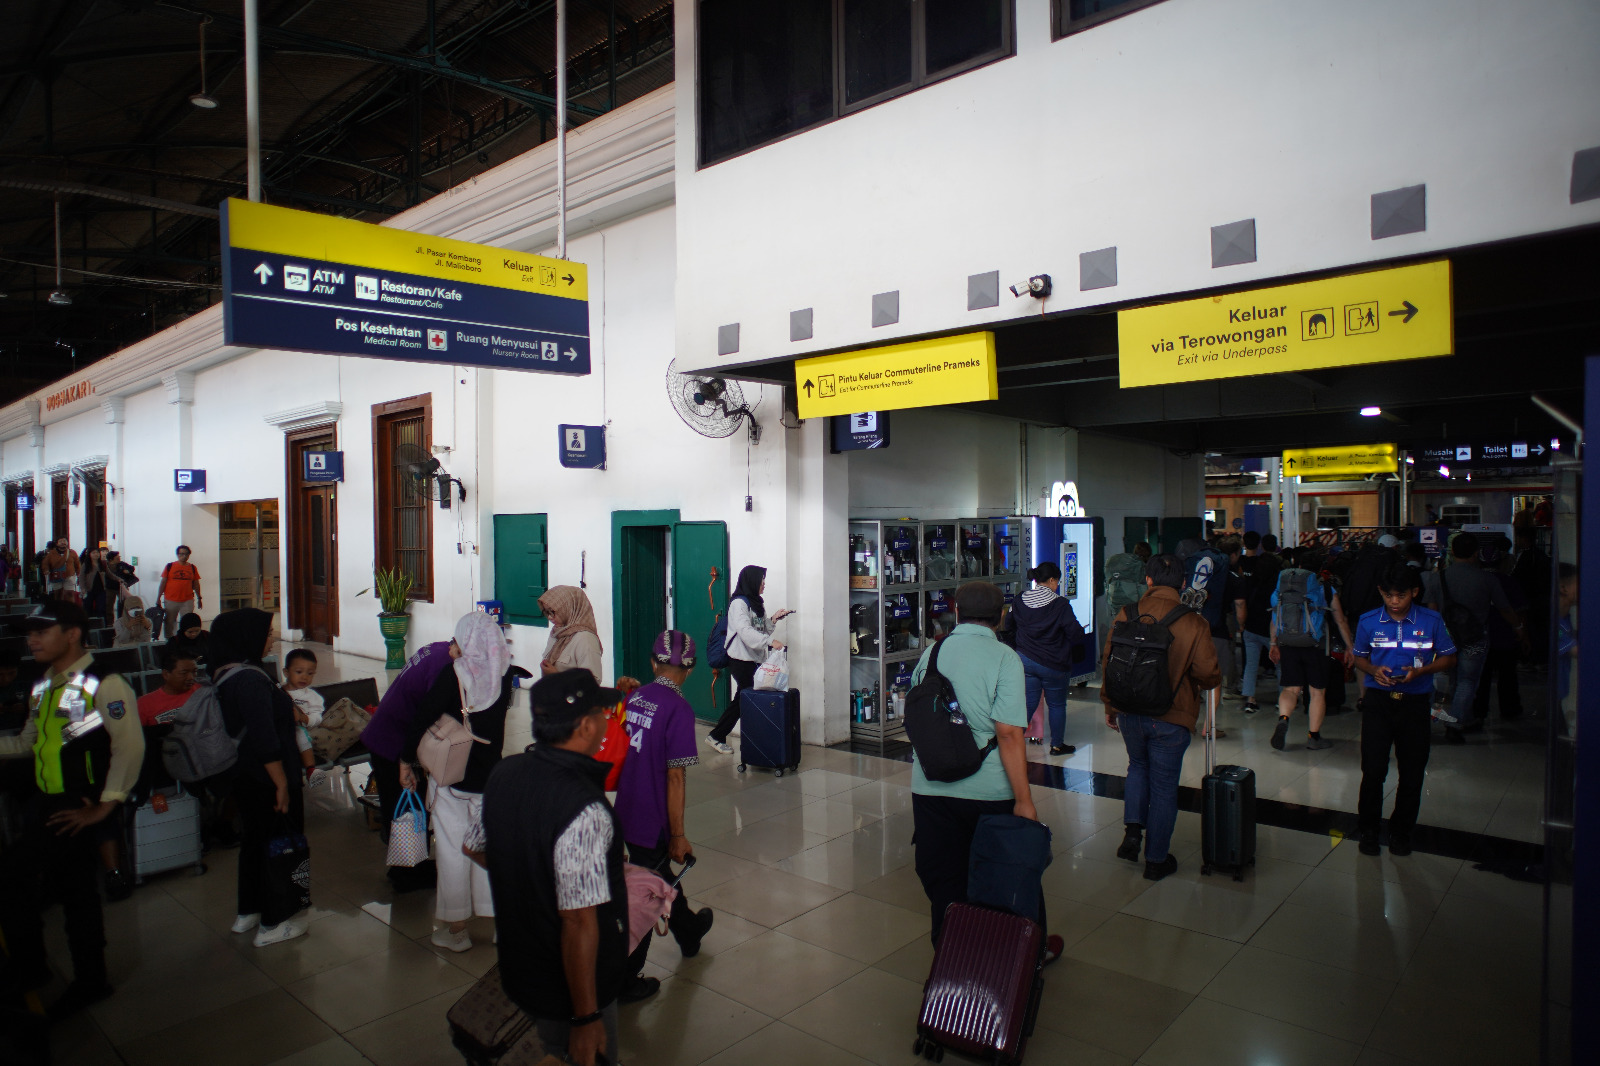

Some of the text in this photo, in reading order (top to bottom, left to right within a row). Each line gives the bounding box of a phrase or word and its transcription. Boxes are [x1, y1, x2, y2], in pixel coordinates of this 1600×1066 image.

[415, 246, 424, 256] Jl.
[426, 247, 446, 260] Pasar
[434, 258, 482, 273] Jl. Malioboro
[502, 258, 534, 273] Keluar
[312, 270, 345, 285] ATM
[521, 274, 534, 284] Exit
[312, 284, 335, 296] ATM
[380, 279, 462, 302] Restoran/Kafe
[380, 293, 444, 310] Restaurant/Cafe
[1229, 305, 1287, 324] Keluar
[335, 318, 422, 338] Pos Kesehatan
[364, 336, 422, 350] Medical Room
[456, 331, 538, 353] Ruang Menyusui
[1151, 324, 1288, 354] via Terowongan
[492, 348, 539, 360] Nursery Room
[1177, 343, 1288, 366] Exit via Underpass
[838, 358, 980, 384] Pintu Keluar Commuterline Prameks
